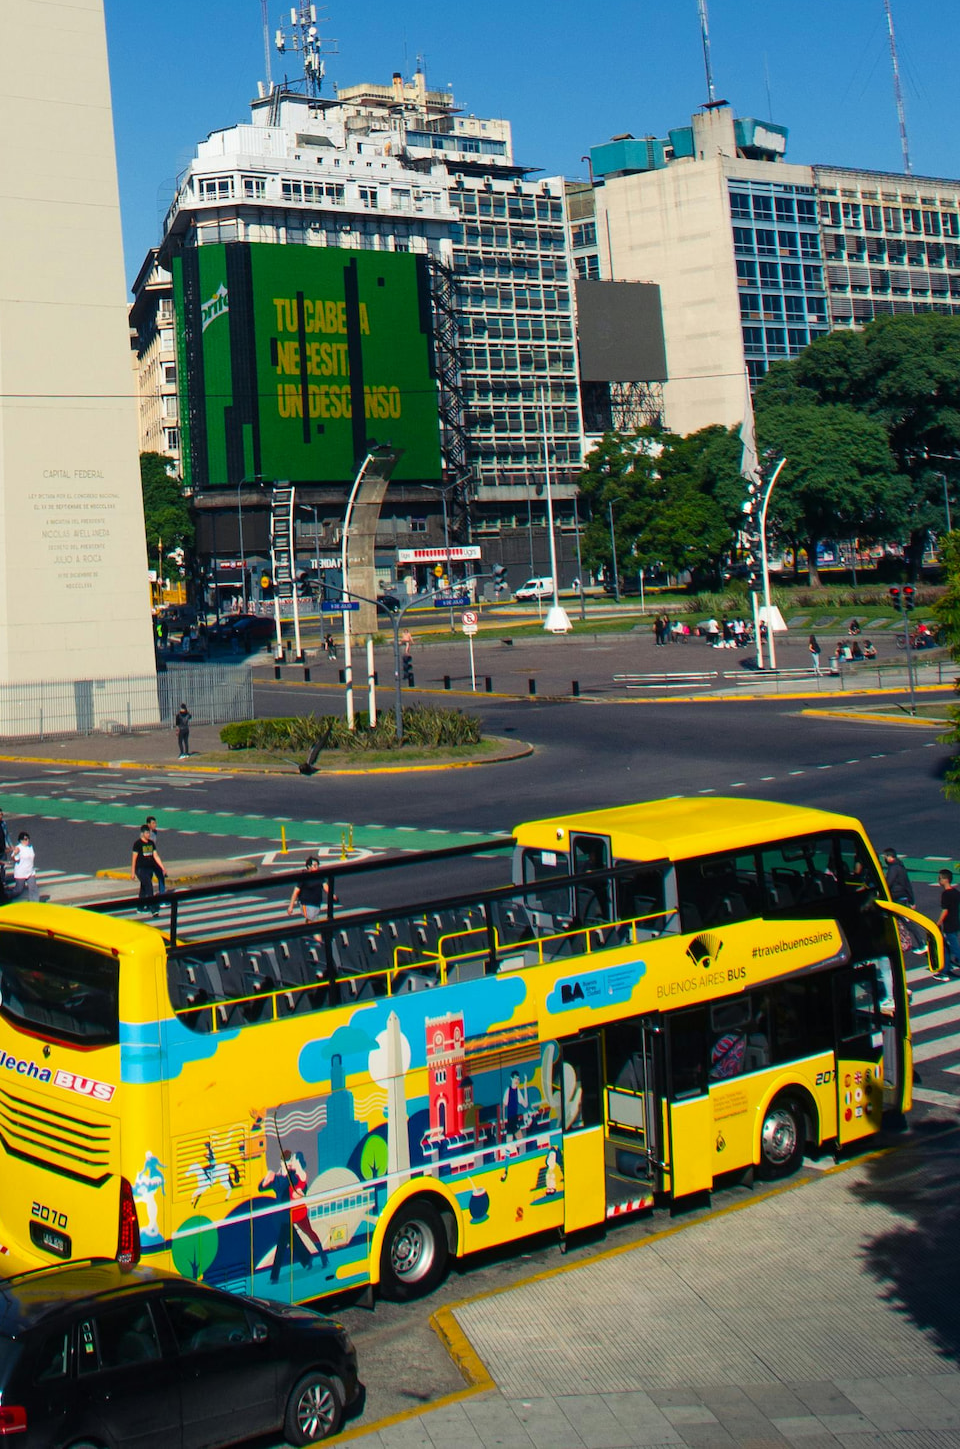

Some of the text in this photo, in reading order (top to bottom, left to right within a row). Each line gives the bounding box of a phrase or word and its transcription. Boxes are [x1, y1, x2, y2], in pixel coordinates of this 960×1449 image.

[273, 298, 370, 335] TU CABEA
[276, 341, 351, 376] NECESIT
[277, 384, 401, 419] UN DESCNSO
[43, 469, 105, 479] CAPITAL FEDERAL
[83, 554, 102, 562] ROCA
[751, 931, 833, 959] #travelbuenosaires
[561, 982, 585, 1004] BA
[656, 978, 697, 998] BUENOS
[699, 970, 726, 989] AIRES
[727, 966, 746, 982] BUS
[54, 1072, 114, 1100] BUS
